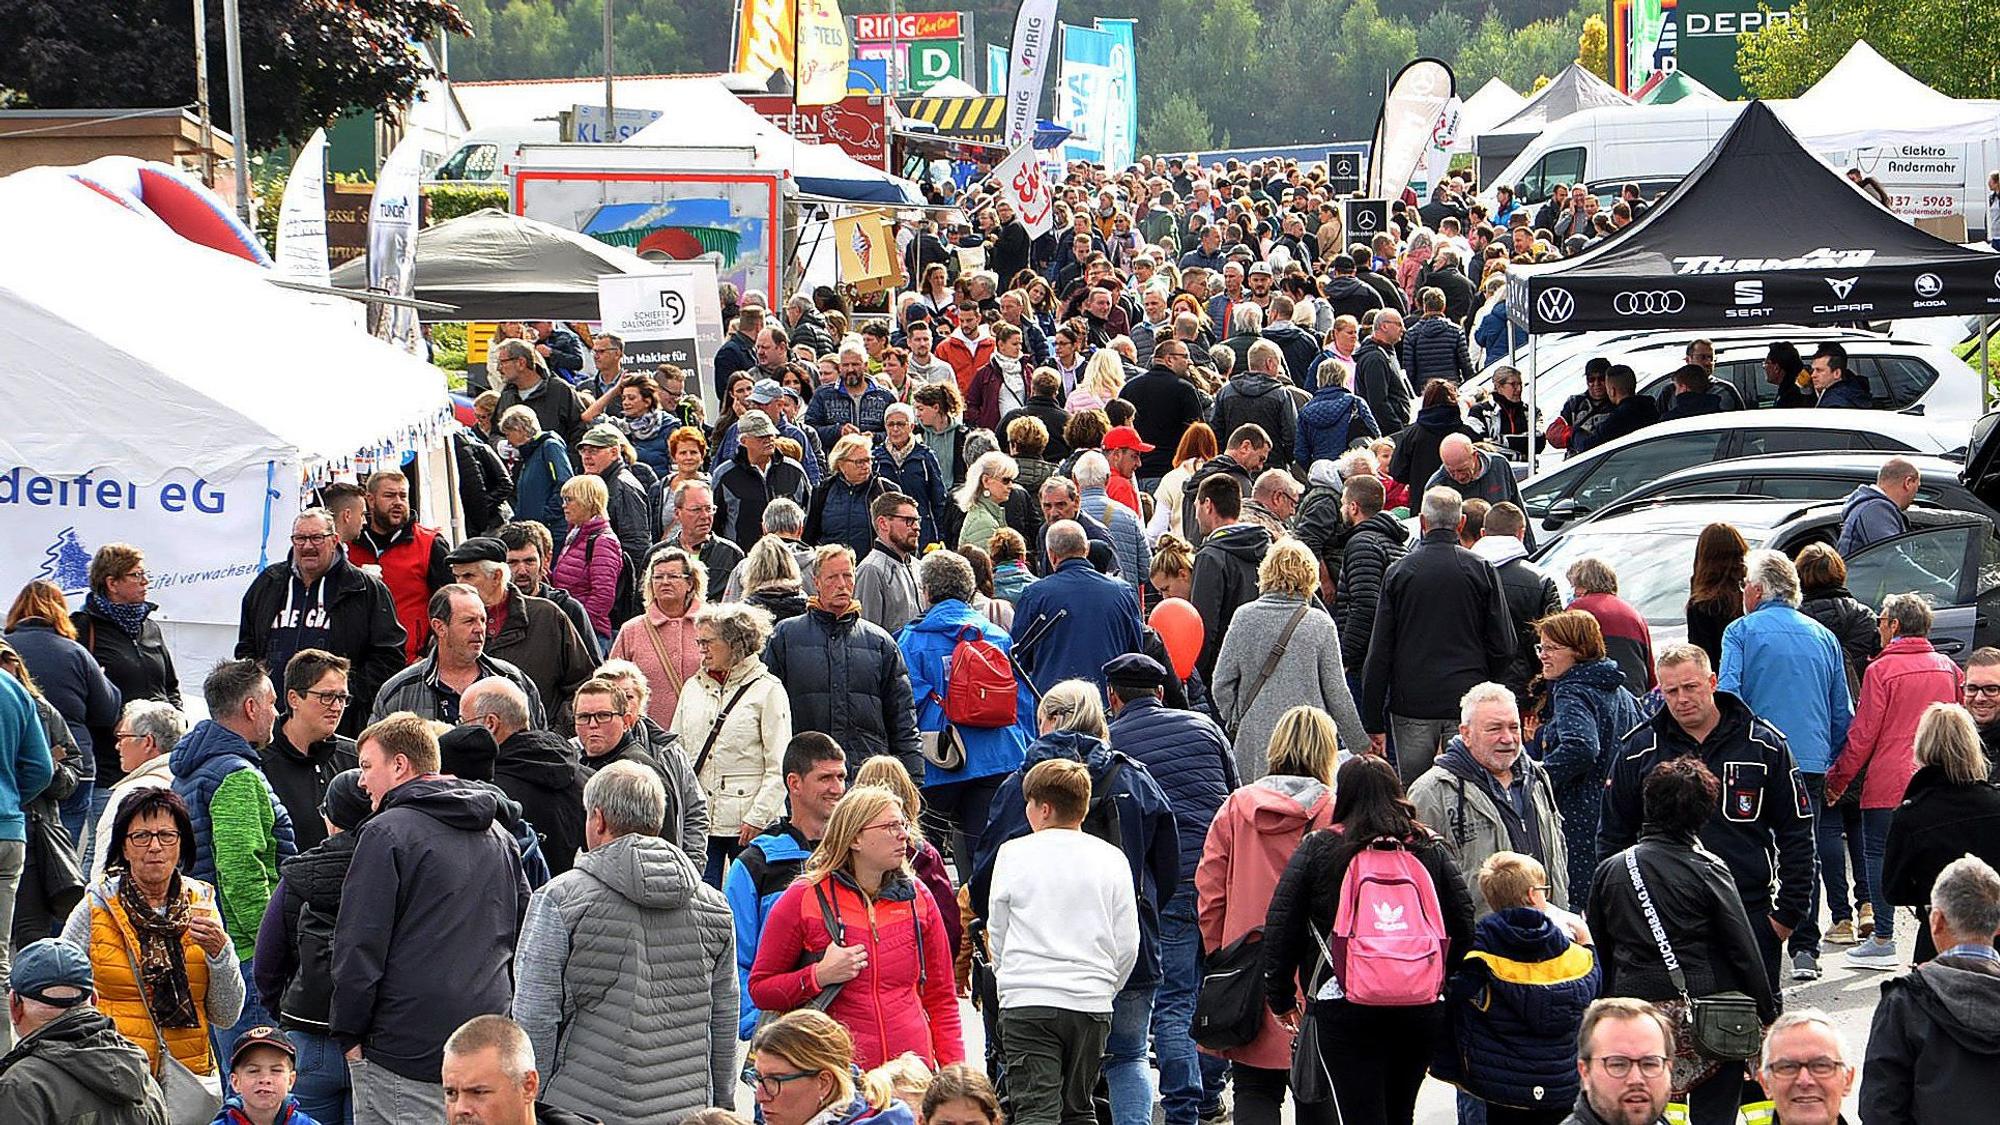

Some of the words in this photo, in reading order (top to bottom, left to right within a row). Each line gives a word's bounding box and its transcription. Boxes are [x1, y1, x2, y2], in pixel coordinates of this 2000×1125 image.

[859, 16, 915, 38] RING
[1686, 12, 1809, 34] DEP
[1024, 16, 1041, 58] PIRIG
[1014, 90, 1030, 132] PIRIG
[1902, 146, 1946, 156] Elektro
[1888, 161, 1956, 173] Andermahr
[1923, 196, 1953, 207] 5963
[1813, 303, 1874, 313] CUPRA
[1914, 299, 1948, 308] ŠKODA
[1726, 308, 1773, 318] SEAT
[636, 351, 671, 364] Makler
[672, 350, 688, 362] für
[160, 478, 225, 514] eG
